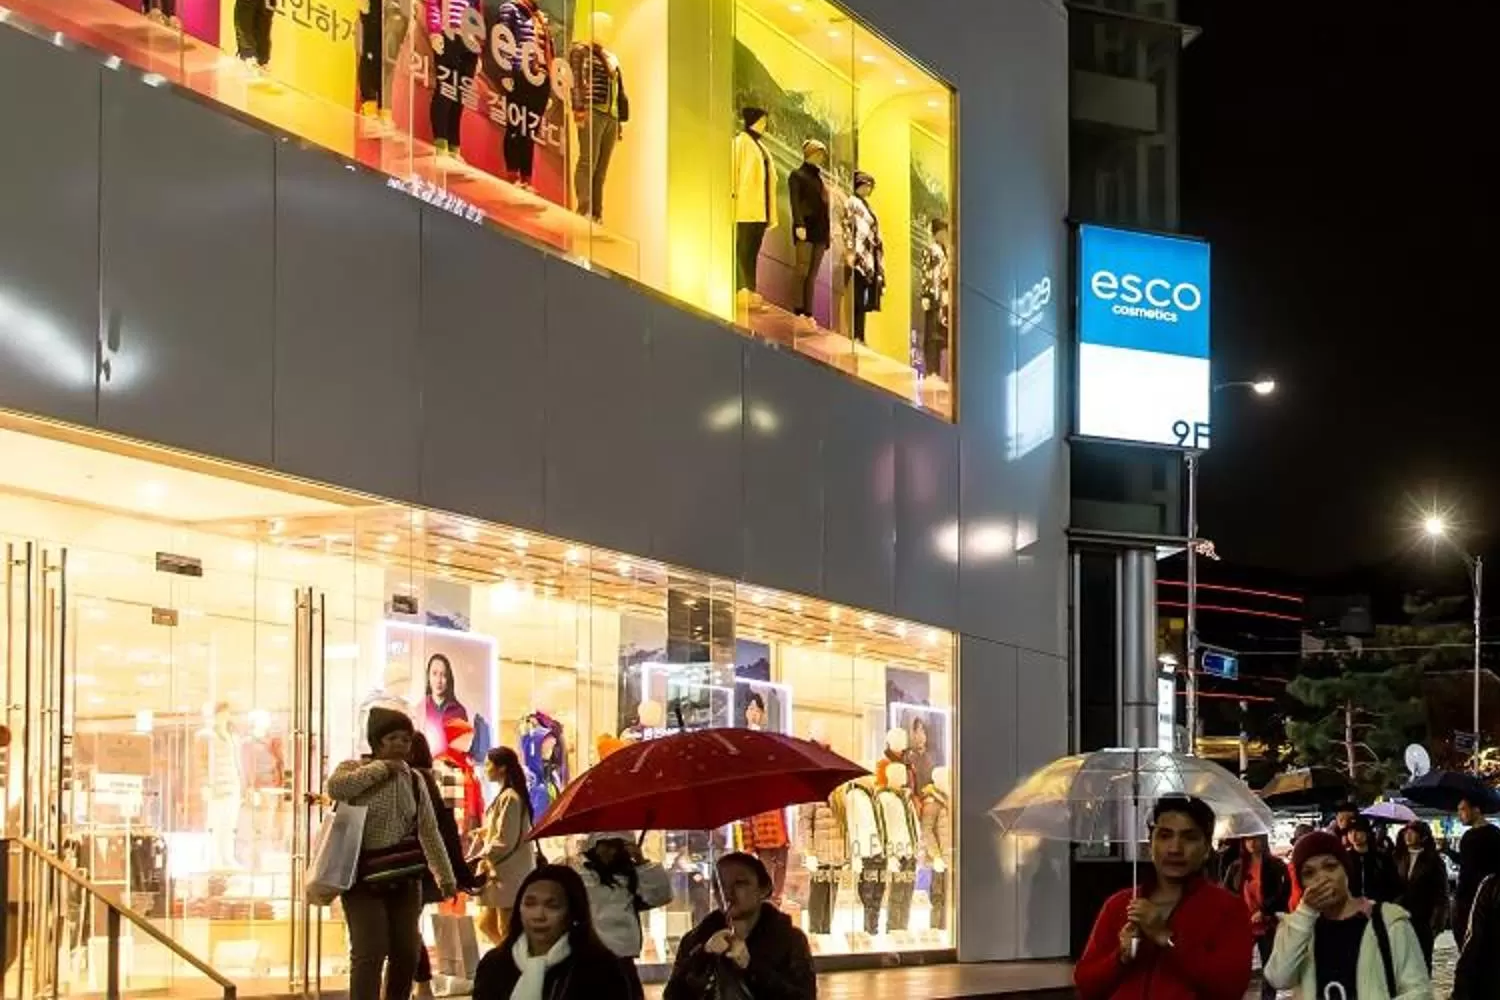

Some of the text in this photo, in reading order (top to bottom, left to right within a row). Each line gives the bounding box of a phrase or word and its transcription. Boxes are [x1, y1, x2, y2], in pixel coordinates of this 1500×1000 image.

[1091, 269, 1201, 311] esco
[1111, 303, 1179, 324] cosmetics
[1172, 420, 1211, 448] 9F
